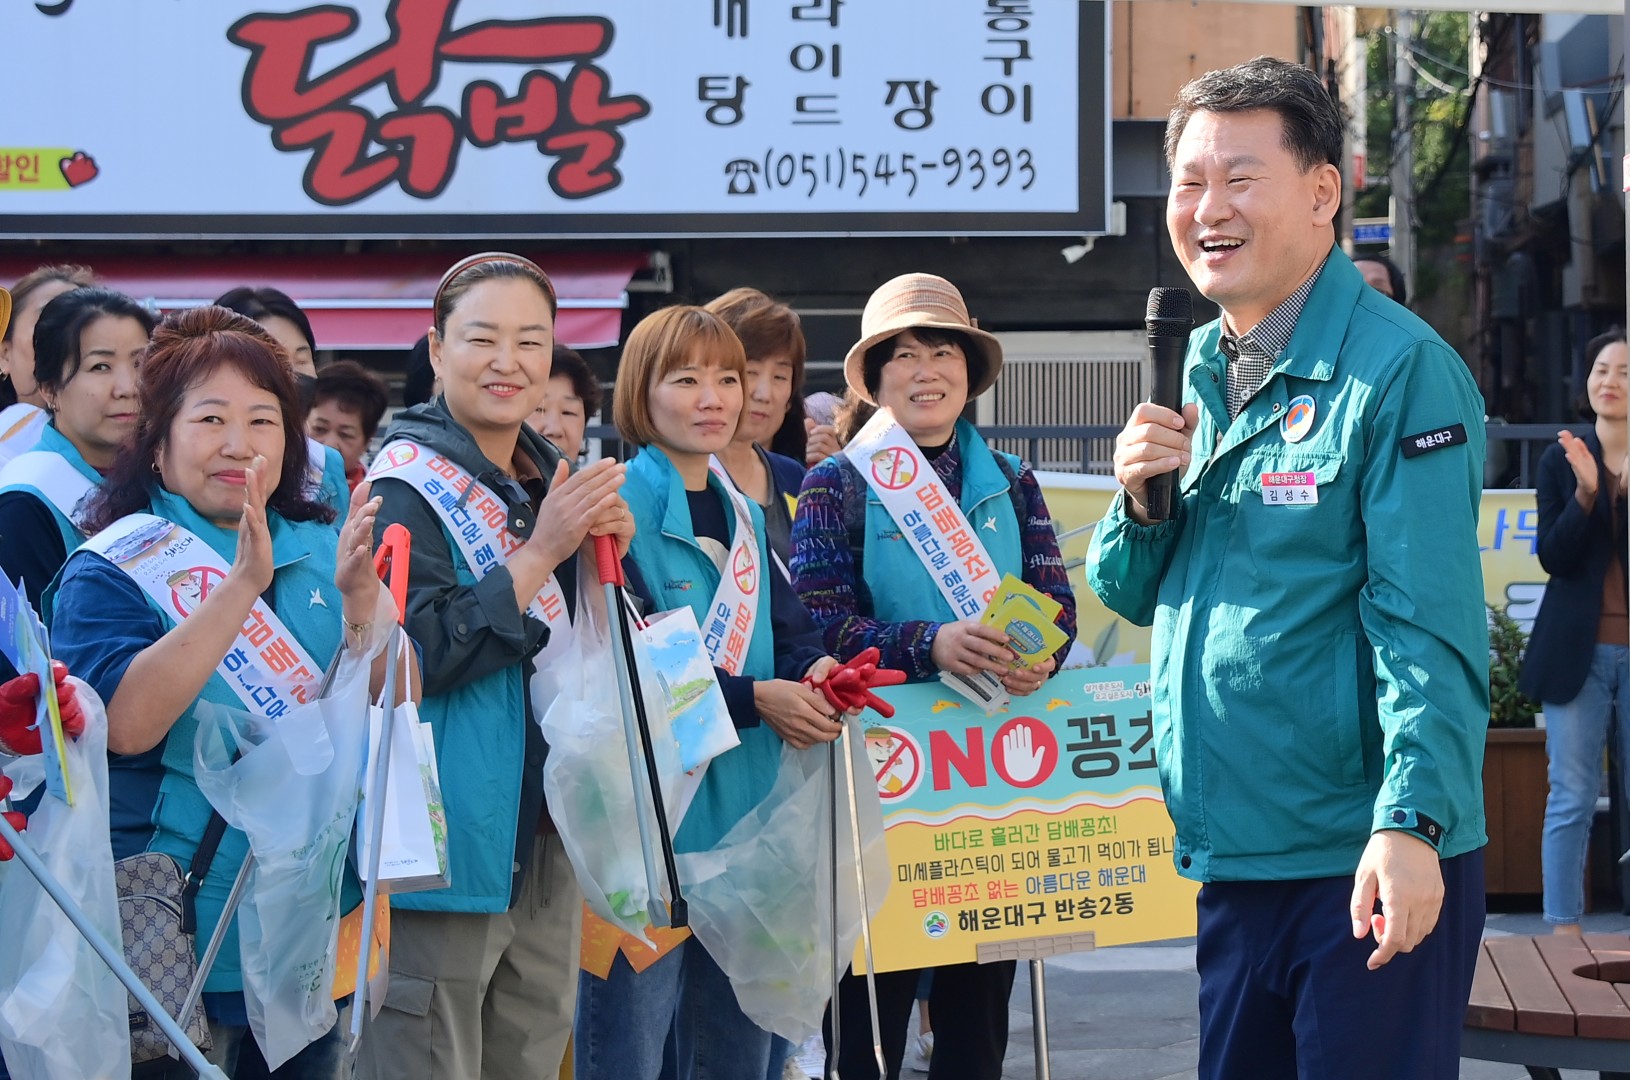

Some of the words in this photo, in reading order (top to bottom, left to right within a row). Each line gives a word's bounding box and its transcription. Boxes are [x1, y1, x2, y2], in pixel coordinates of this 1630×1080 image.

[764, 147, 1036, 198] (051)545-9393
[1415, 430, 1453, 449] 해운대구
[915, 482, 991, 582] 담배꽁초
[902, 509, 951, 571] 아름다운
[941, 569, 980, 617] 해운대
[934, 829, 984, 851] 바다로
[991, 823, 1040, 847] 흘러간
[1047, 815, 1117, 841] 담배꽁초!
[897, 853, 1005, 882] 미세플라스틱이
[1011, 849, 1041, 870] 되어
[1047, 844, 1091, 868] 물고기
[1097, 839, 1142, 861] 먹이가
[912, 882, 980, 908] 담배꽁초
[986, 879, 1019, 900] 없는
[1026, 869, 1091, 895] 아름다운
[1097, 864, 1147, 887] 해운대
[957, 901, 1047, 932] 해운대구
[1055, 891, 1134, 922] 반송2동
